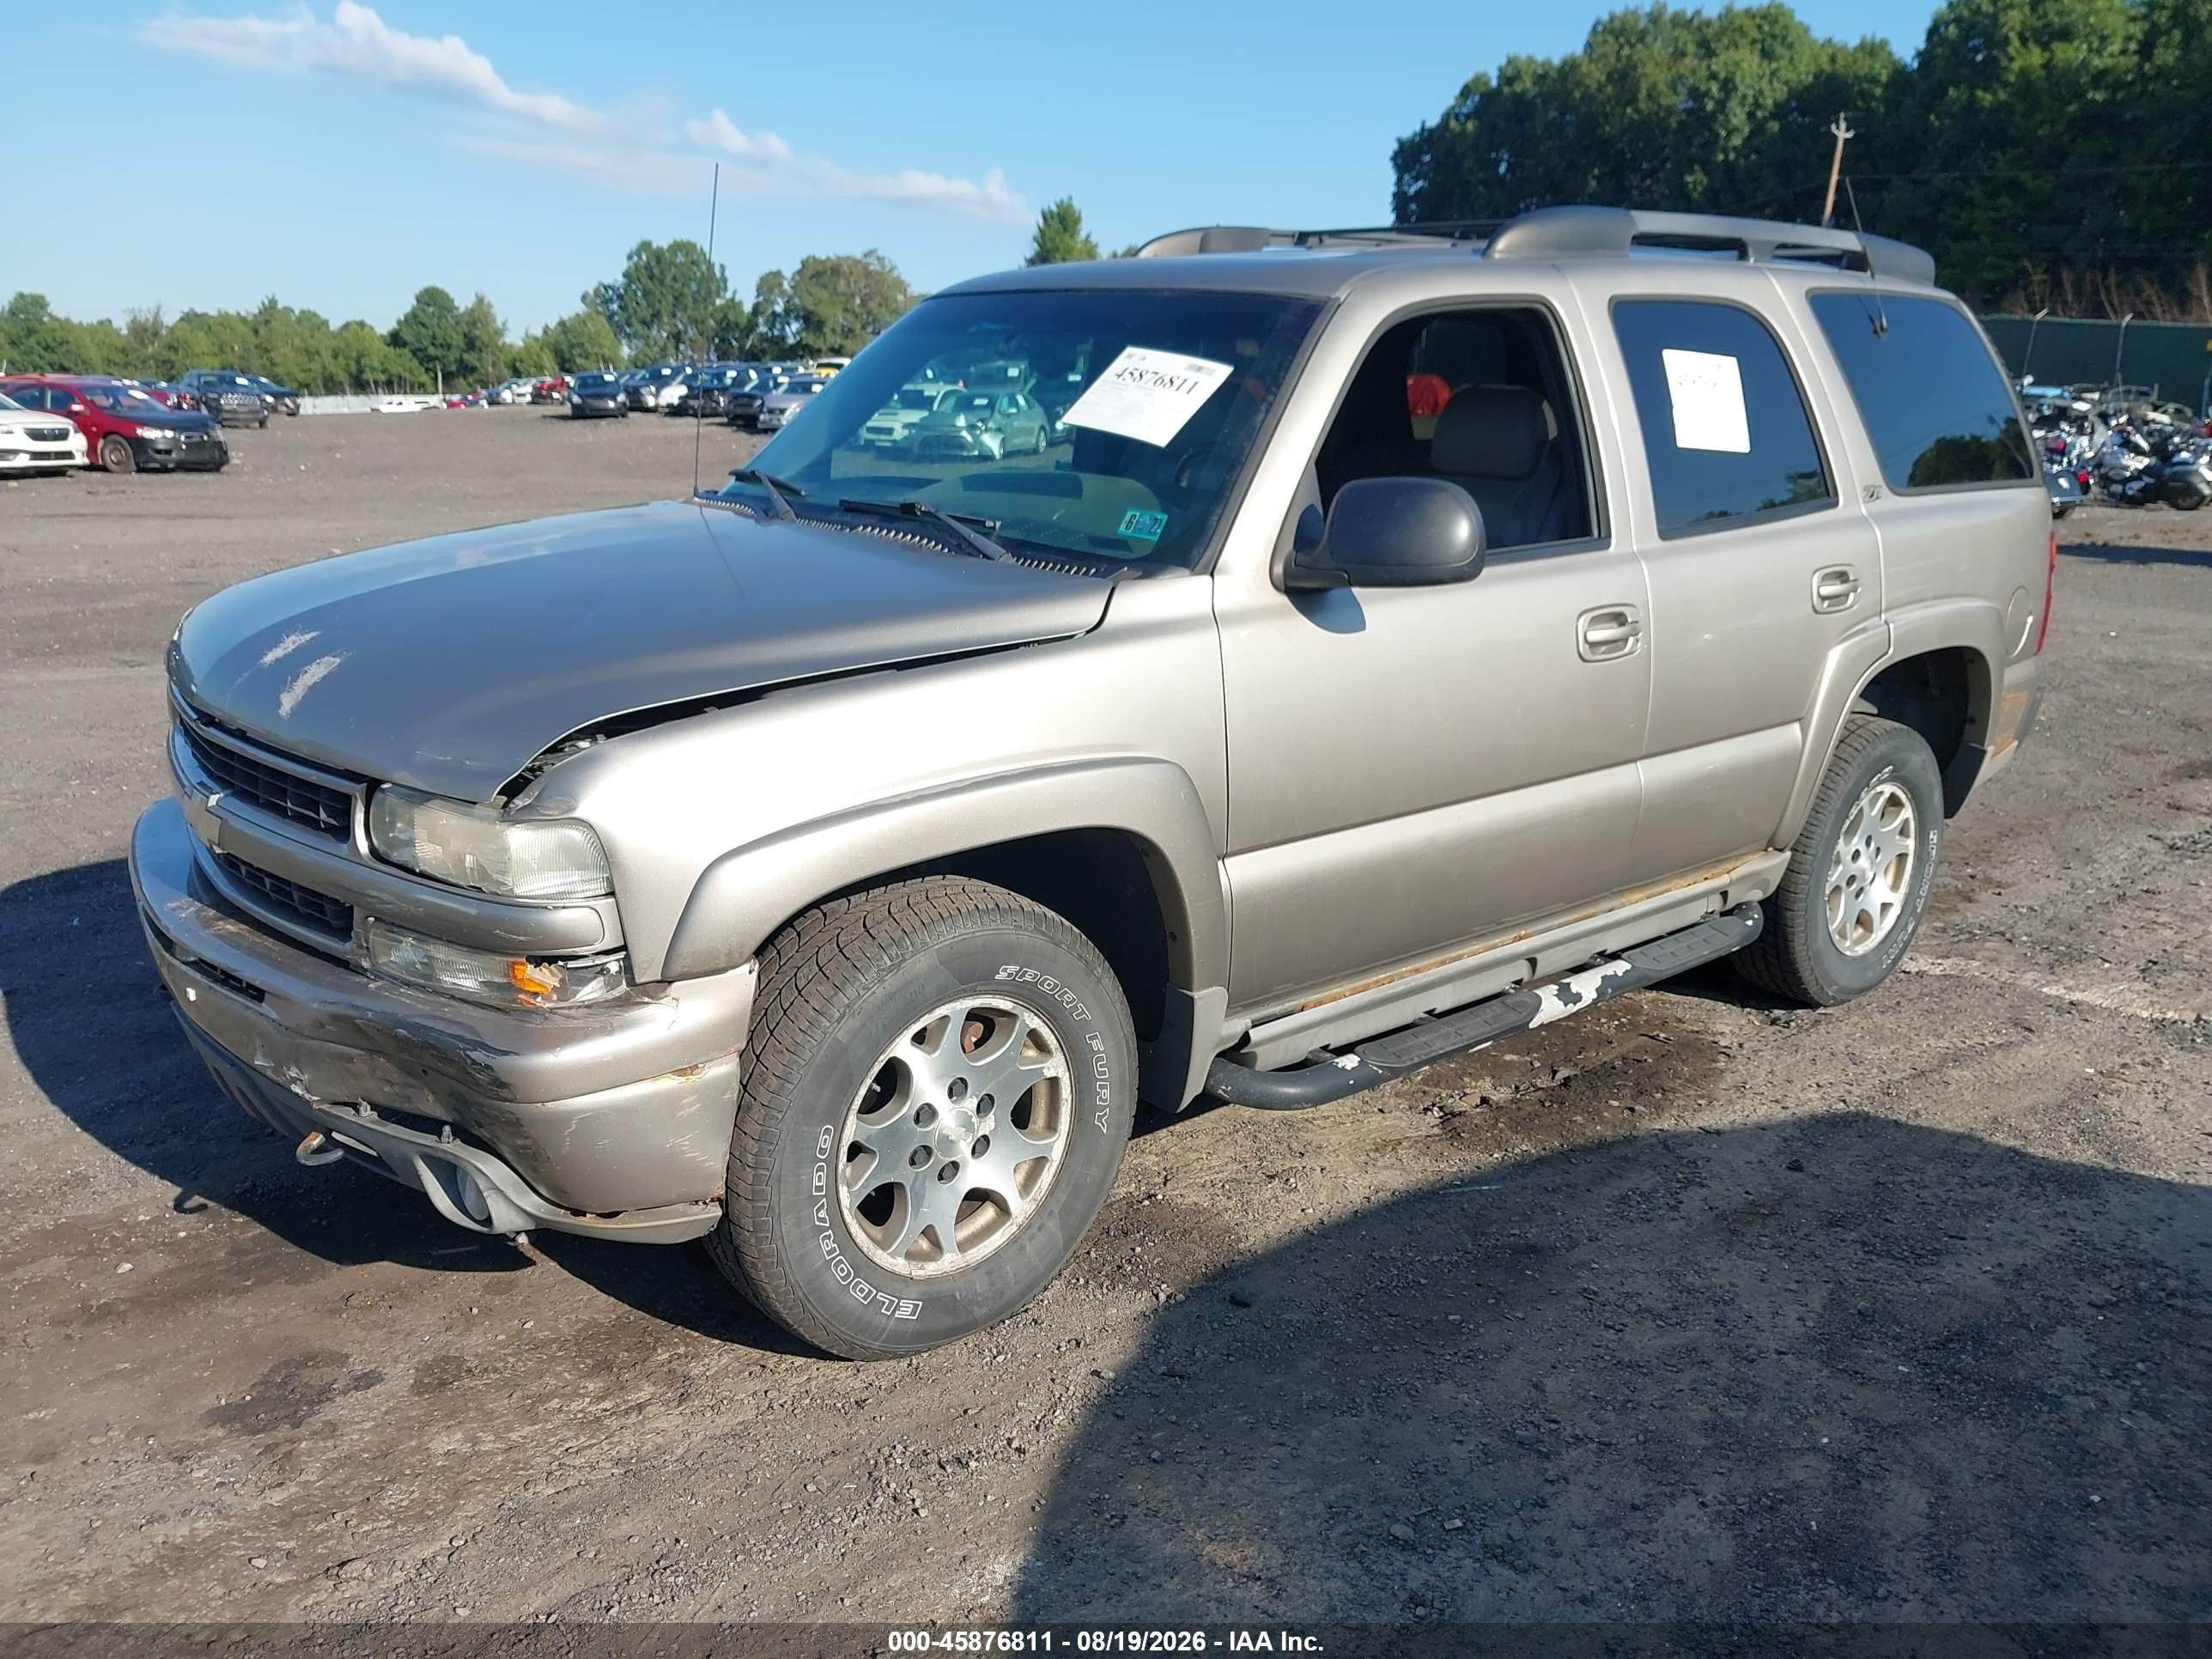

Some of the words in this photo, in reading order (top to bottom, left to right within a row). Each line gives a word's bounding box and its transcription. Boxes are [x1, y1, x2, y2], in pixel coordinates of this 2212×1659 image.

[1115, 367, 1200, 394] 45876811
[1125, 514, 1138, 531] 6
[994, 964, 1092, 1023] SPORT
[1085, 1030, 1112, 1133] FURY
[812, 1124, 923, 1320] ELDORADO
